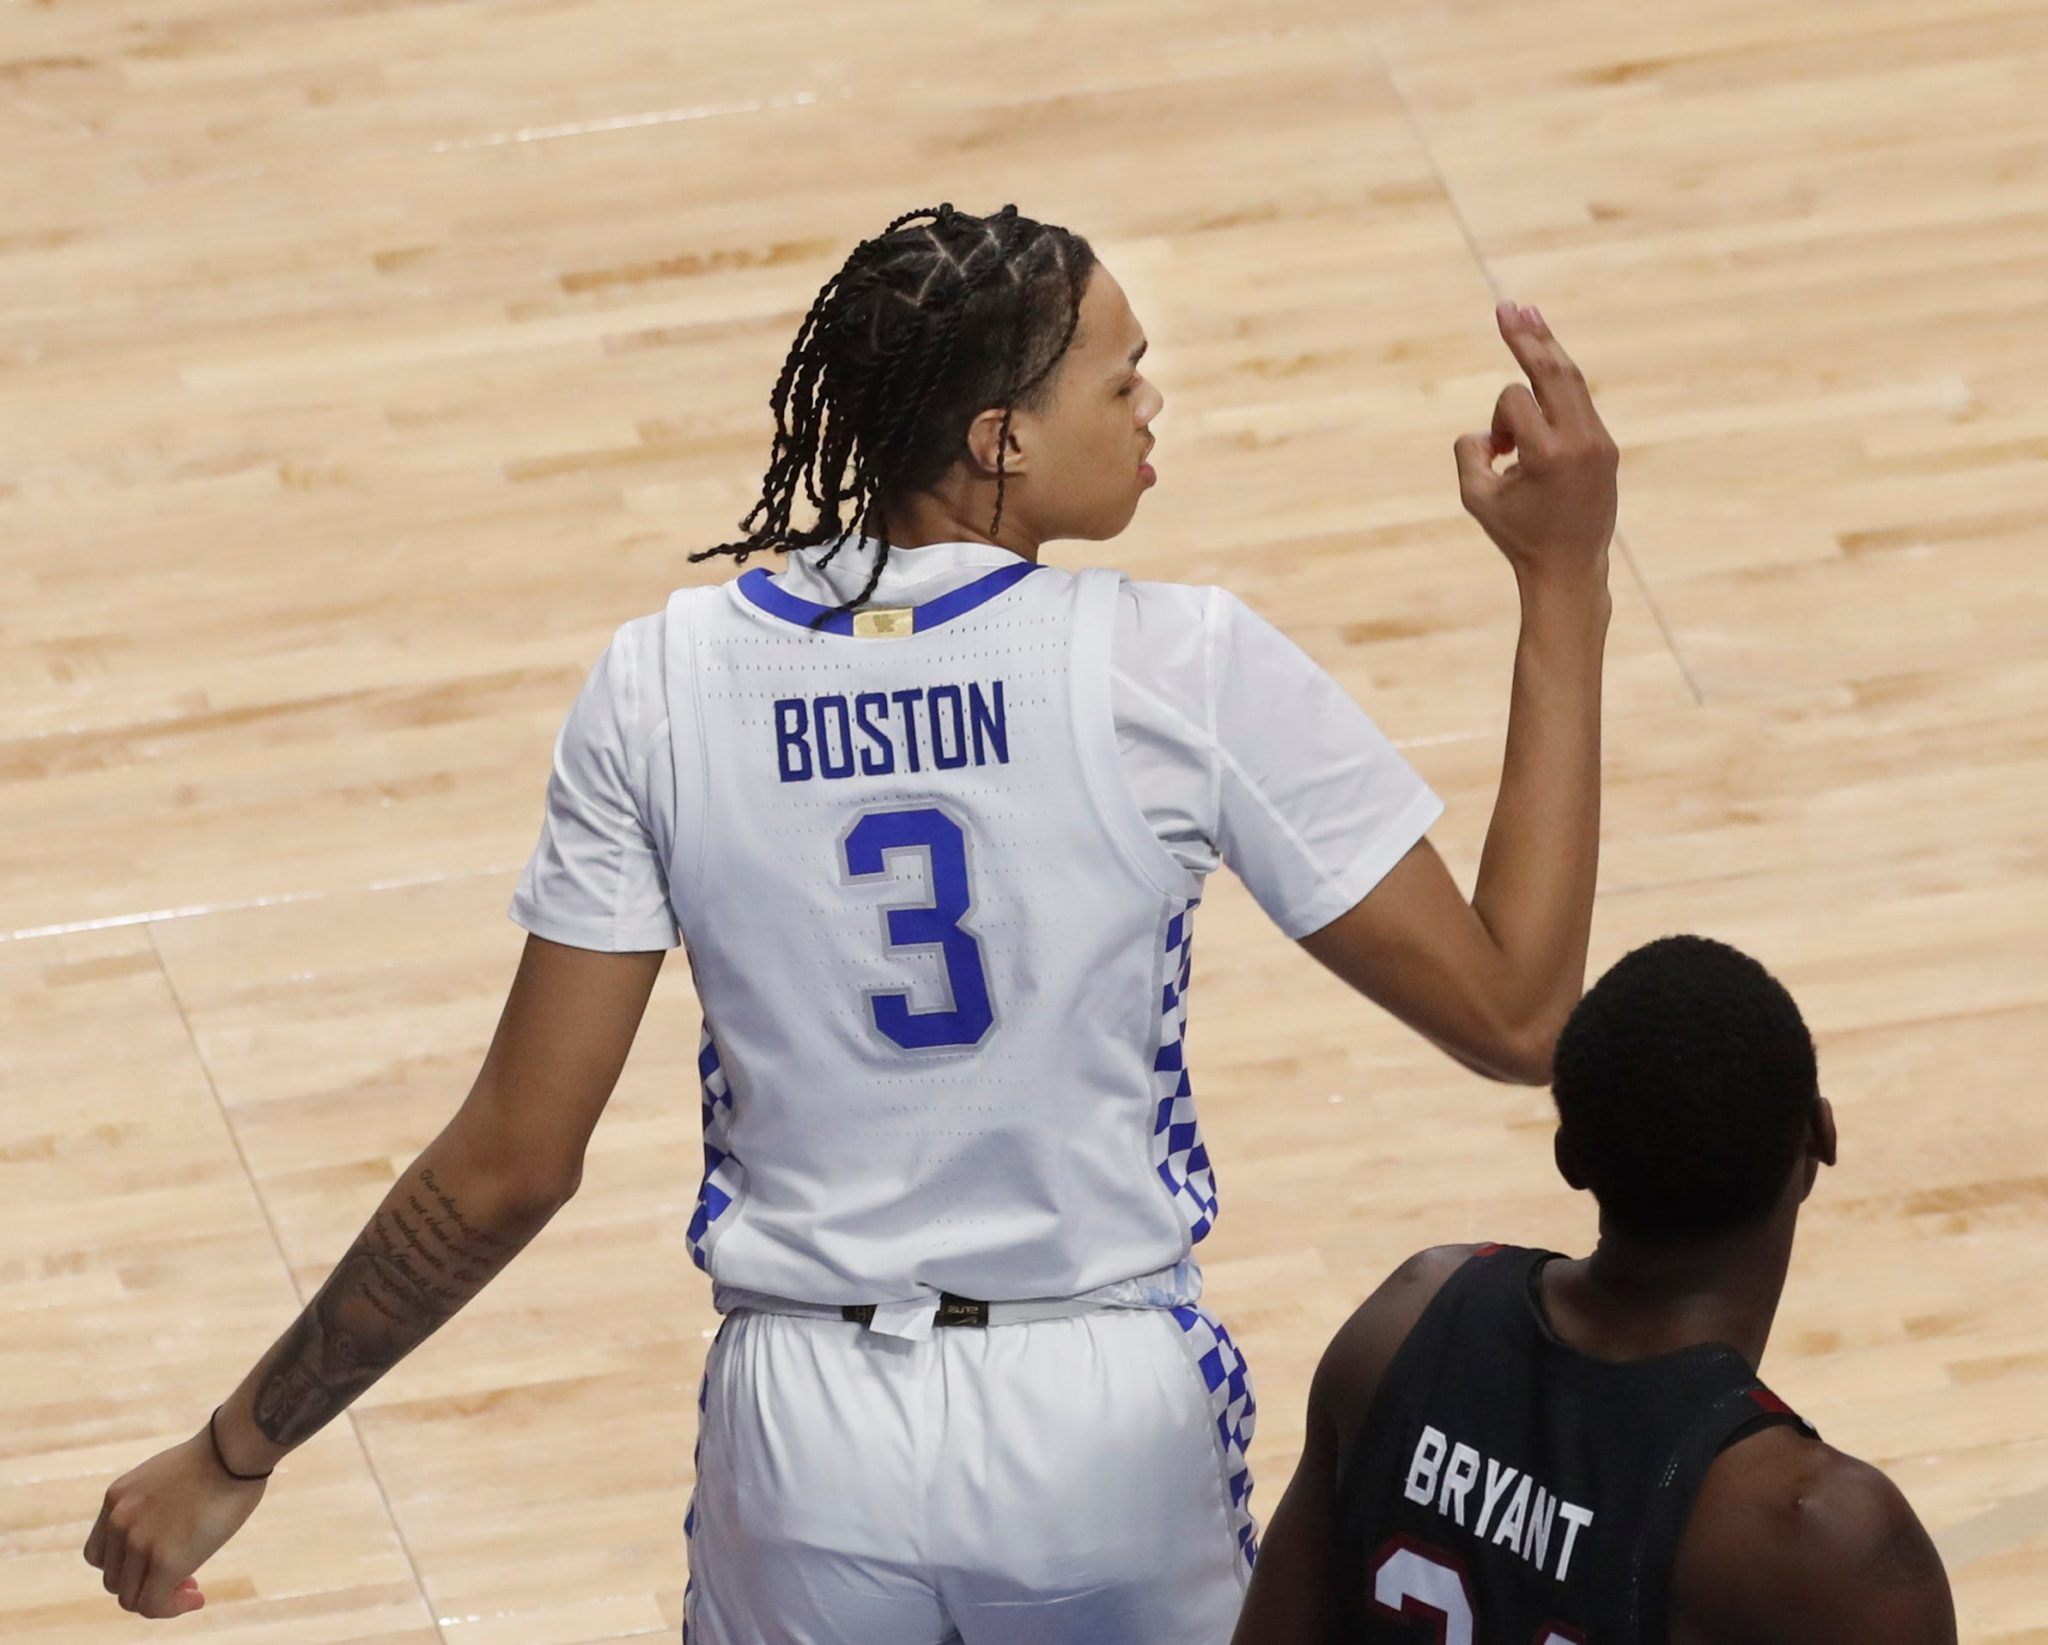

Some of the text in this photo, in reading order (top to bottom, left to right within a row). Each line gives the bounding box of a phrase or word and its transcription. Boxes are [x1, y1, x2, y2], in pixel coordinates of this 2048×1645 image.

[774, 681, 1009, 782] BOSTON
[836, 800, 997, 1058] 3
[1404, 1424, 1594, 1582] BRYANT
